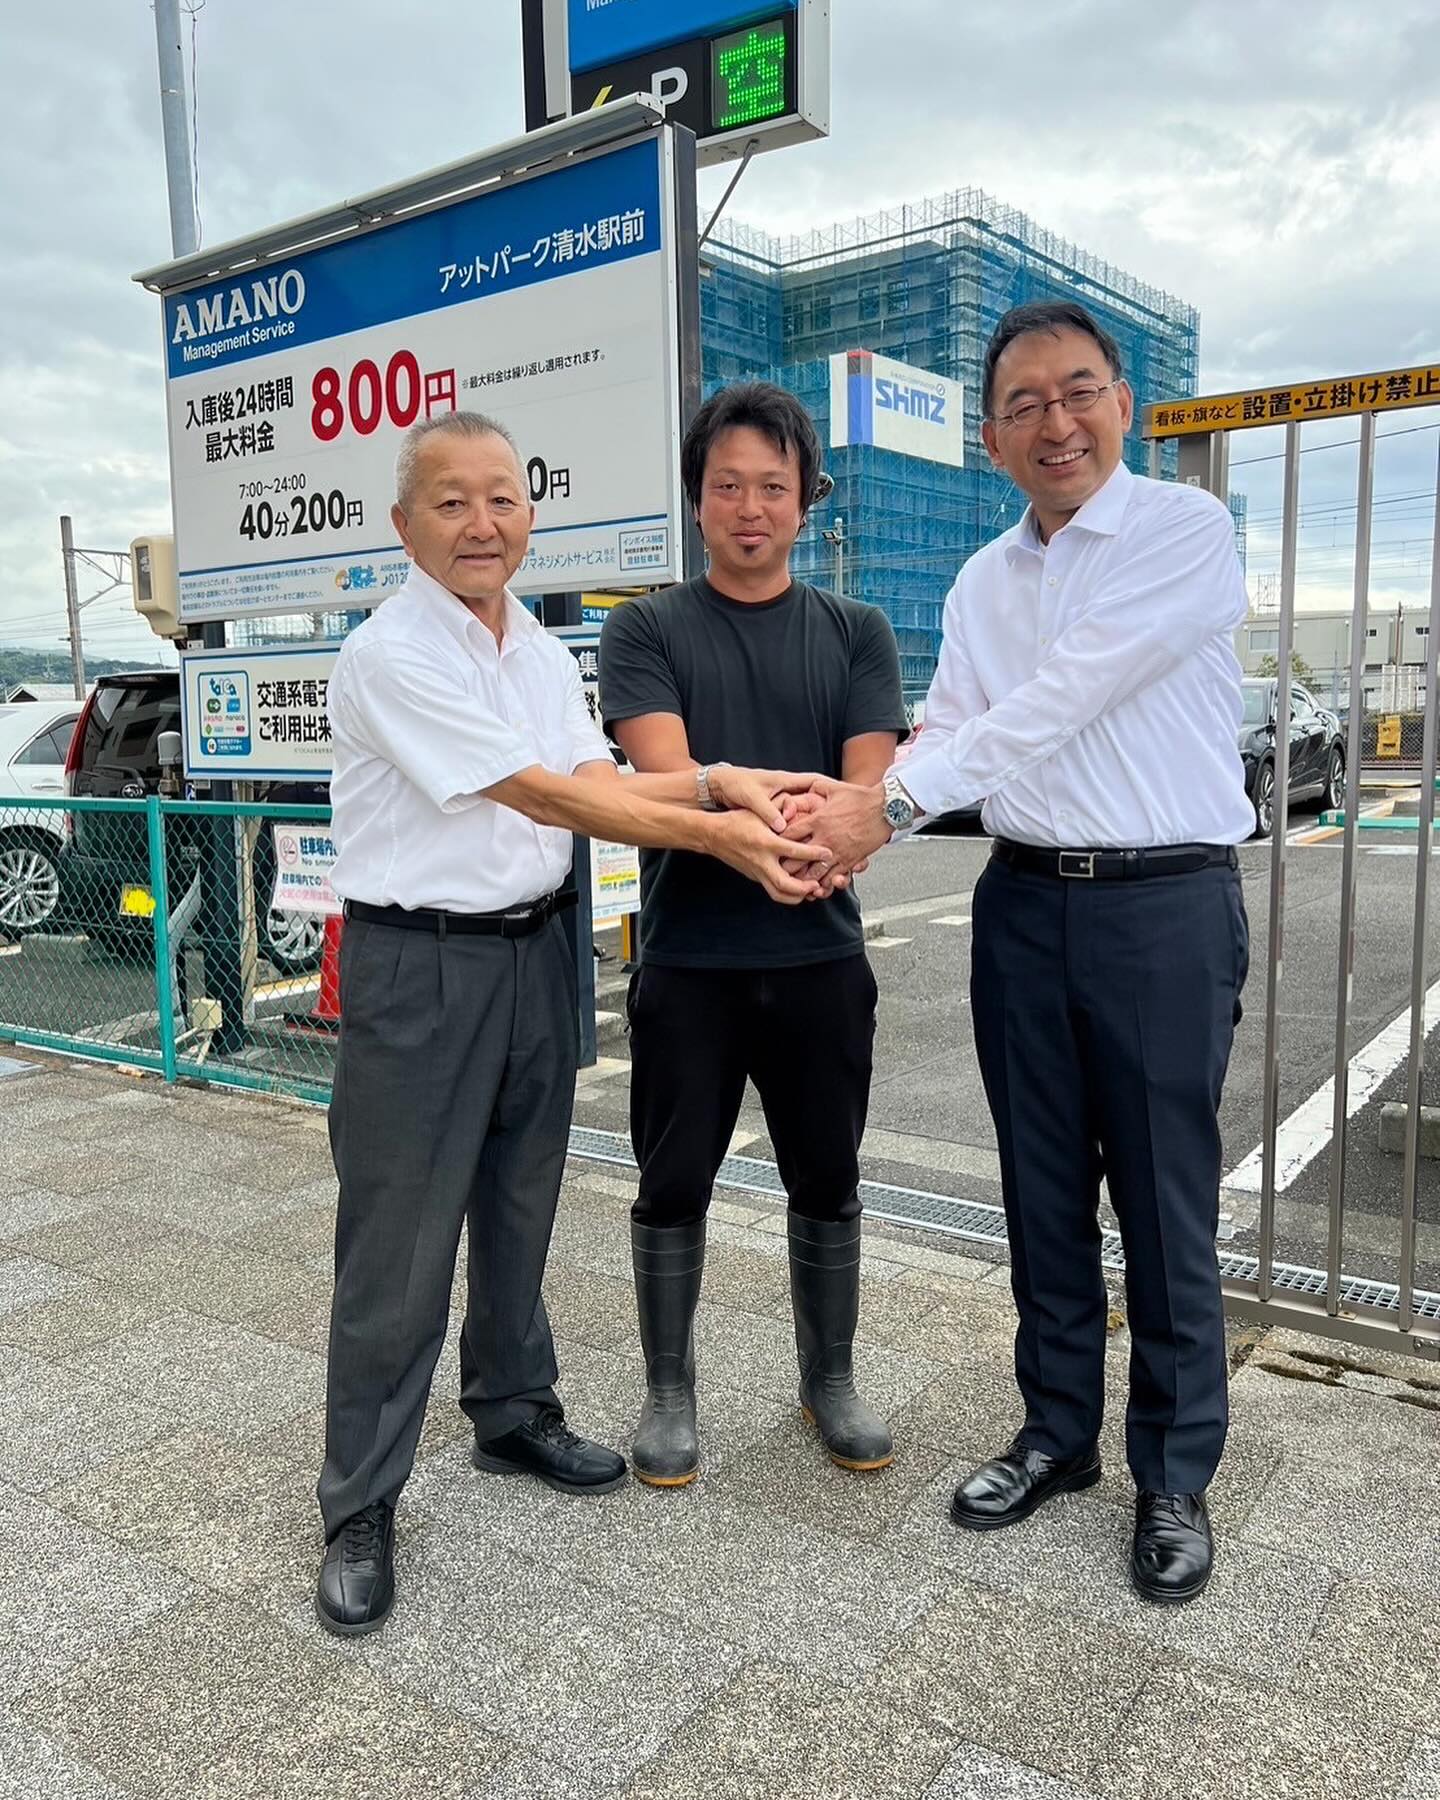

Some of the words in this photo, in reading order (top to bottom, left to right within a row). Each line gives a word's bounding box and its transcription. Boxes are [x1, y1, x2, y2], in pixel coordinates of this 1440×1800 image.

[651, 66, 688, 105] P
[720, 32, 785, 127] 空
[439, 207, 646, 293] アットパーク清水駅前
[172, 269, 306, 344] AMANO
[183, 332, 250, 362] Management
[252, 320, 295, 344] Service
[185, 376, 294, 431] 入庫後24時間
[311, 350, 456, 441] 800円
[206, 420, 275, 463] 最大料金
[240, 489, 364, 541] 40分200円
[259, 714, 333, 742] ご利用出来
